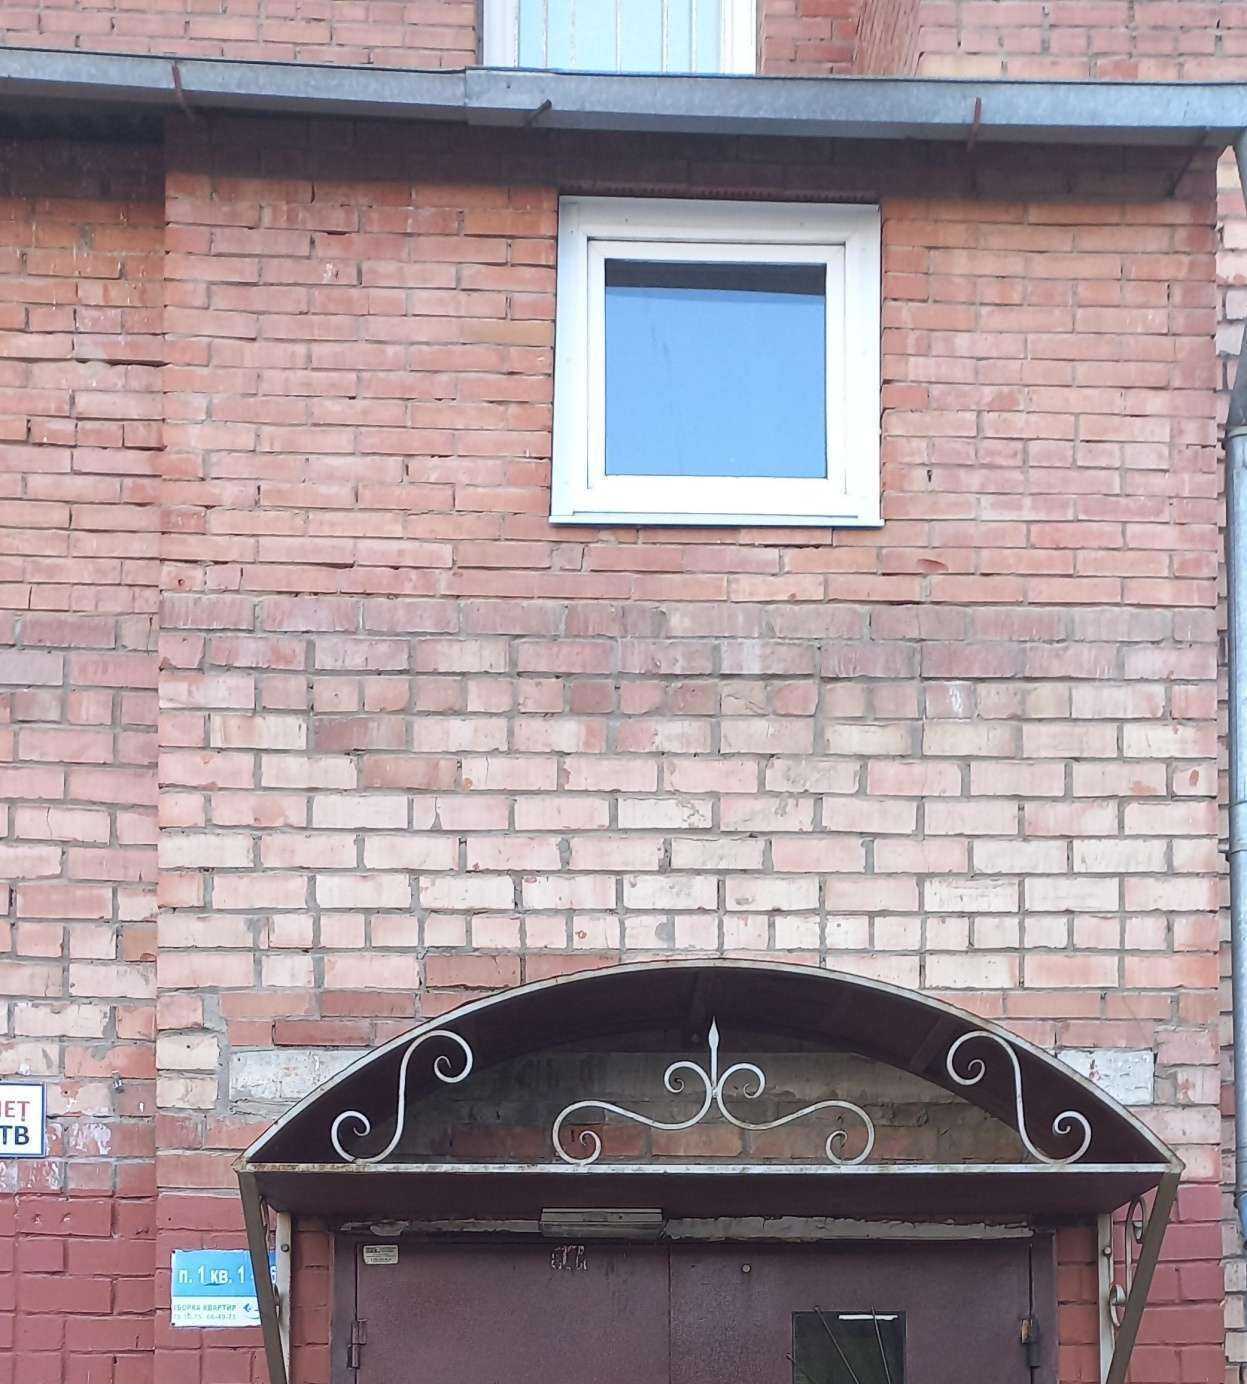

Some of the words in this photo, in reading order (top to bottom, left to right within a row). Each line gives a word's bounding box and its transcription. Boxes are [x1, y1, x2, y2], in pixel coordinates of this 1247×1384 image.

[0, 1100, 30, 1121] ЕТ
[0, 1125, 30, 1145] ТВ
[198, 1265, 205, 1284] 1
[210, 1269, 232, 1284] кв.
[238, 1264, 245, 1284] 1
